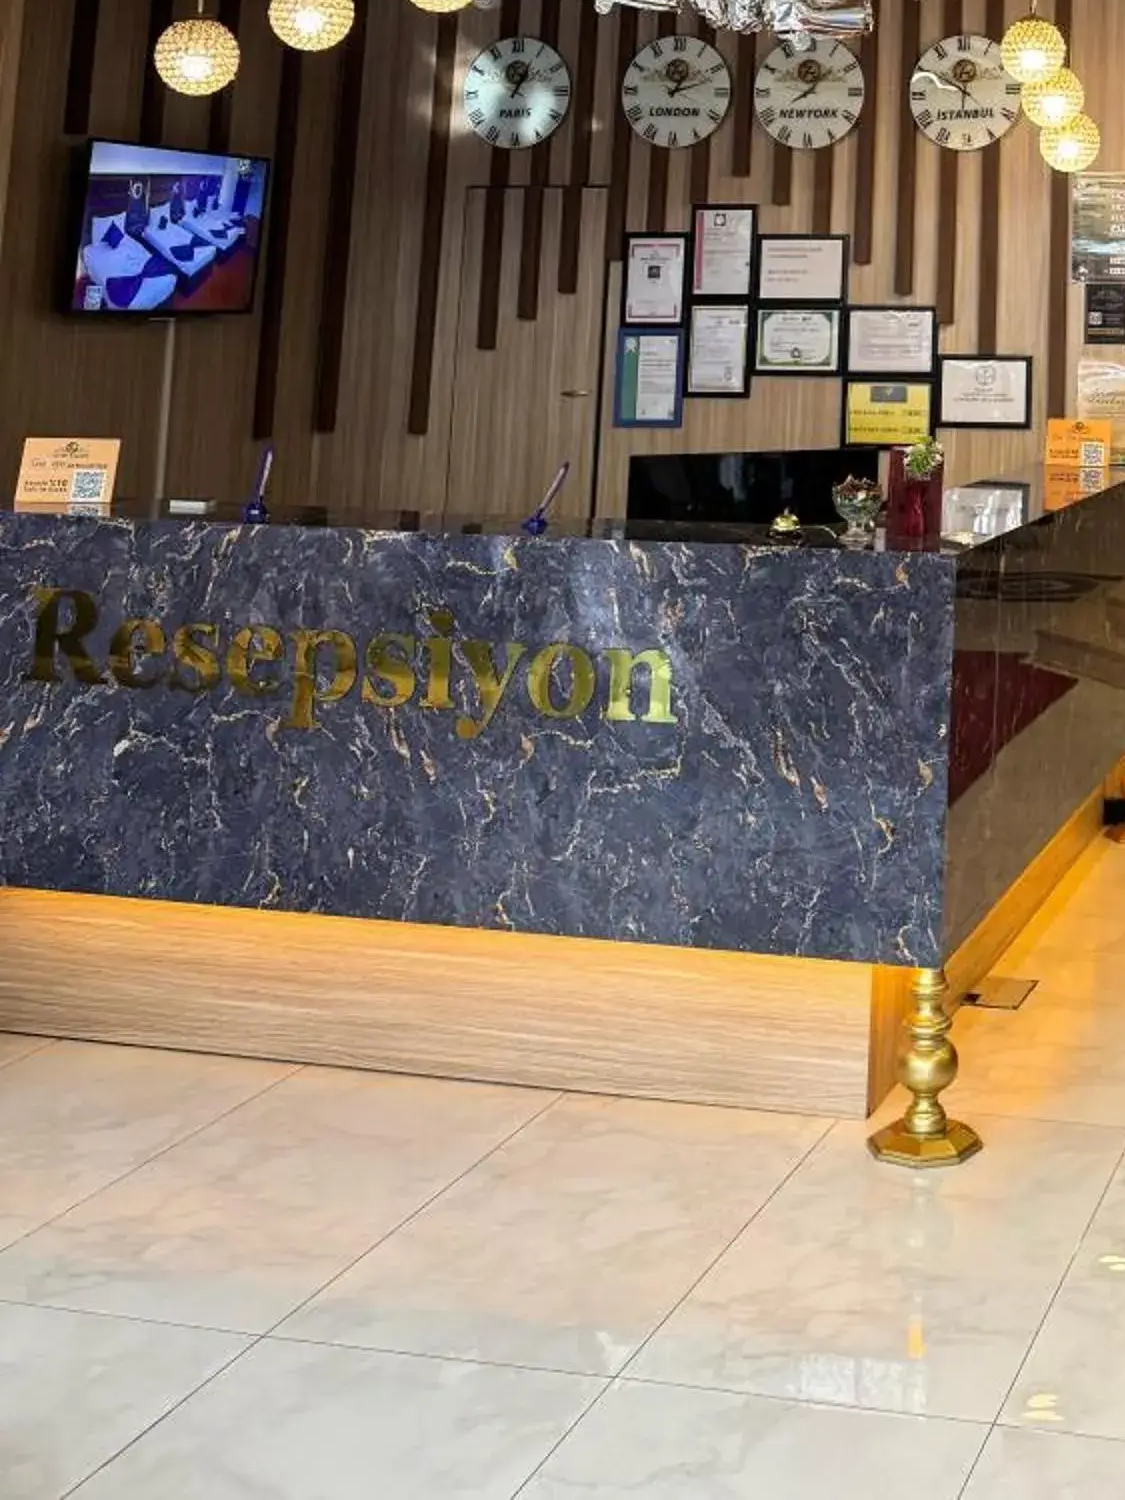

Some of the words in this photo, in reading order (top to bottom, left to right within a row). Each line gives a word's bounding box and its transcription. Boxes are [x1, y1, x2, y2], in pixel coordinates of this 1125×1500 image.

[499, 107, 532, 118] PARIS
[648, 106, 701, 118] LONDON
[26, 586, 679, 741] Resepsiyon
